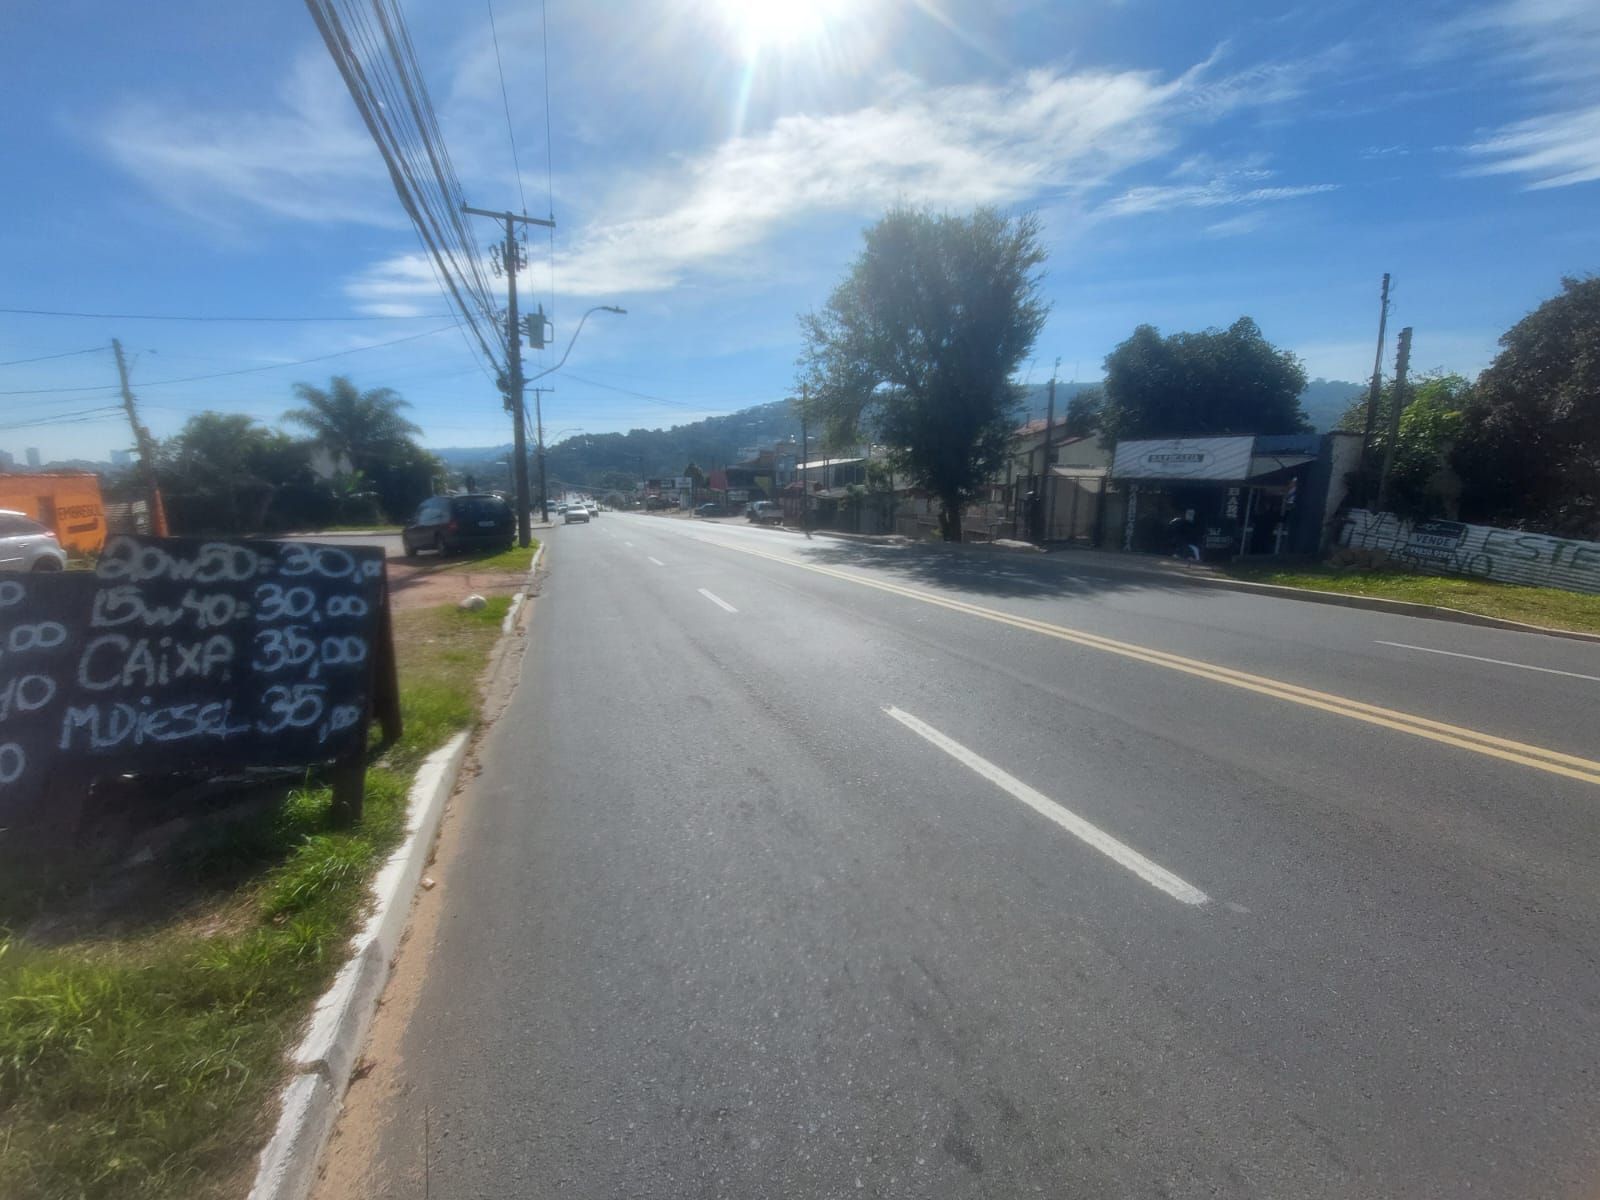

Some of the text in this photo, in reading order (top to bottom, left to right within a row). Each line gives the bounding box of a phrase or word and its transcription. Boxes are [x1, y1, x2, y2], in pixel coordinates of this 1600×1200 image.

[1416, 534, 1451, 547] VENDE
[254, 583, 369, 623] 30,00
[252, 624, 368, 679] 35,00
